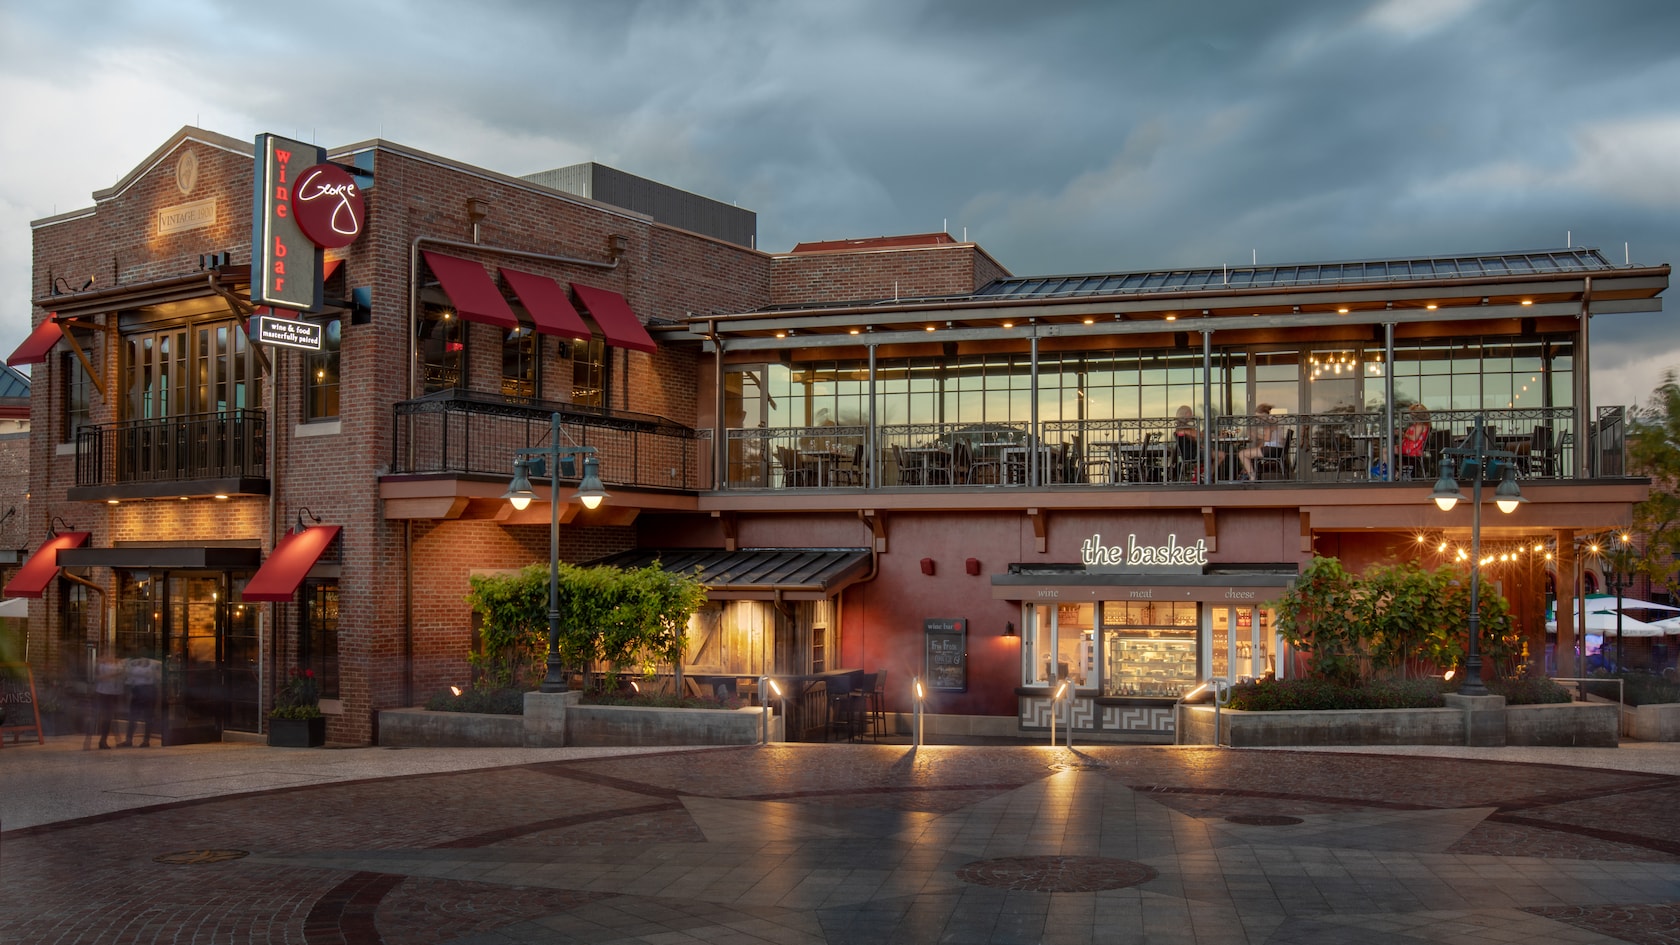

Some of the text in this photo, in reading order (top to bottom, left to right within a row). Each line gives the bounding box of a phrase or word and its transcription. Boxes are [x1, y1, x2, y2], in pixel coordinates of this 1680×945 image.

[299, 170, 359, 235] George
[161, 210, 195, 226] VINTAGE
[274, 149, 291, 292] wine bar
[271, 323, 310, 335] wine & food
[262, 330, 318, 345] masterfully paired
[1080, 533, 1208, 566] the basket
[1037, 588, 1255, 599] wine meat cheese
[927, 622, 954, 630] wine bar
